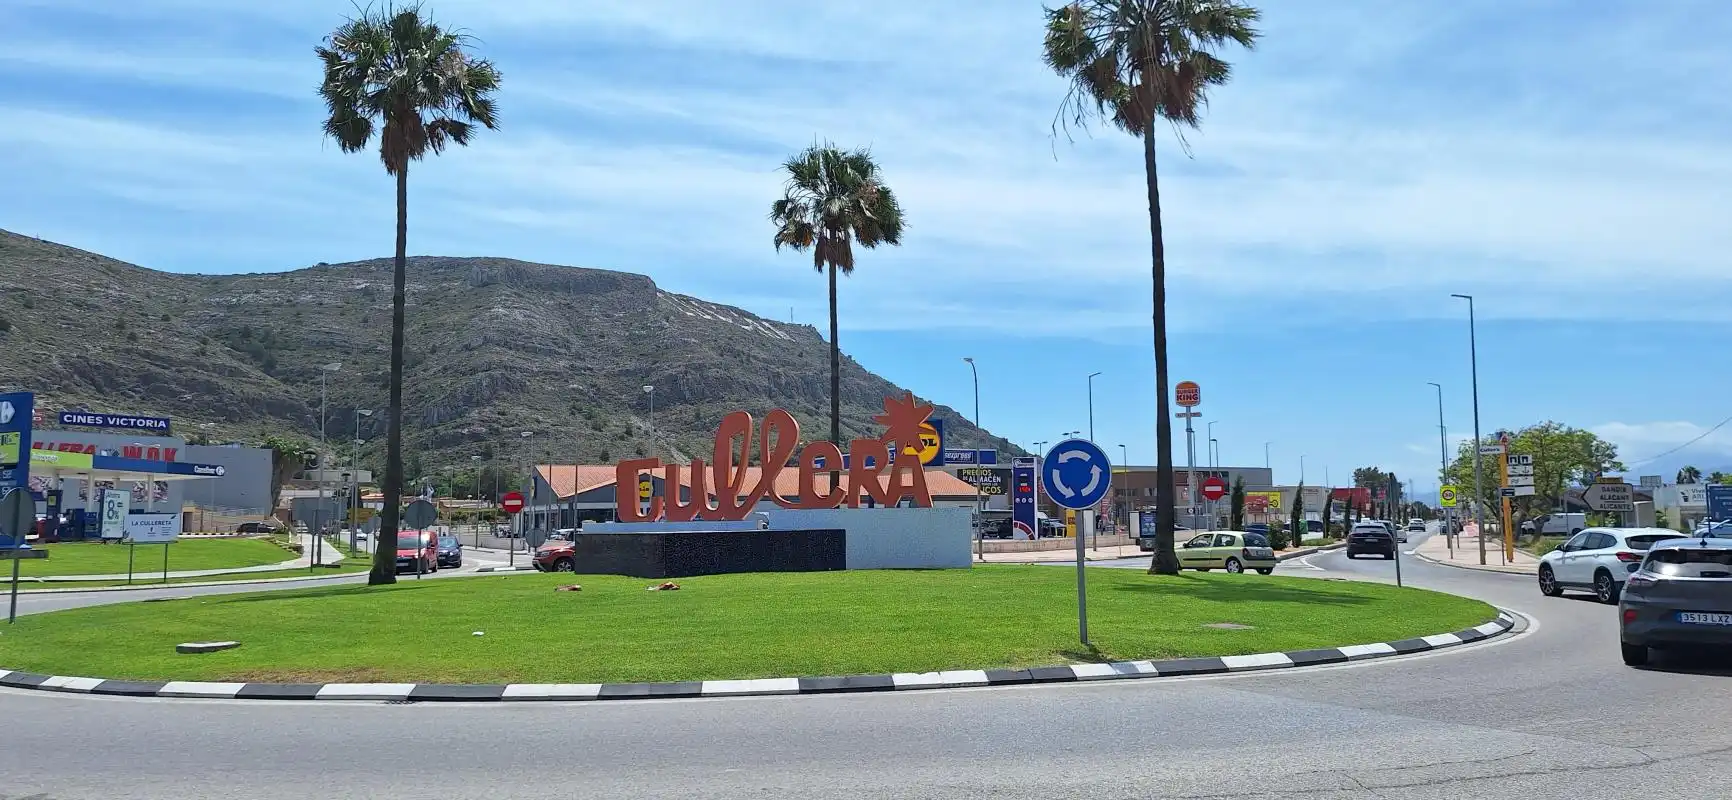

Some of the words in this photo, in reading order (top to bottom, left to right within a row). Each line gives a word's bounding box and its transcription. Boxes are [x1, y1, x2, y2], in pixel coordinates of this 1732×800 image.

[63, 413, 104, 425] CINES
[107, 416, 168, 429] VICTORIA
[1683, 613, 1708, 622] 3513
[1711, 614, 1730, 623] LXZ
